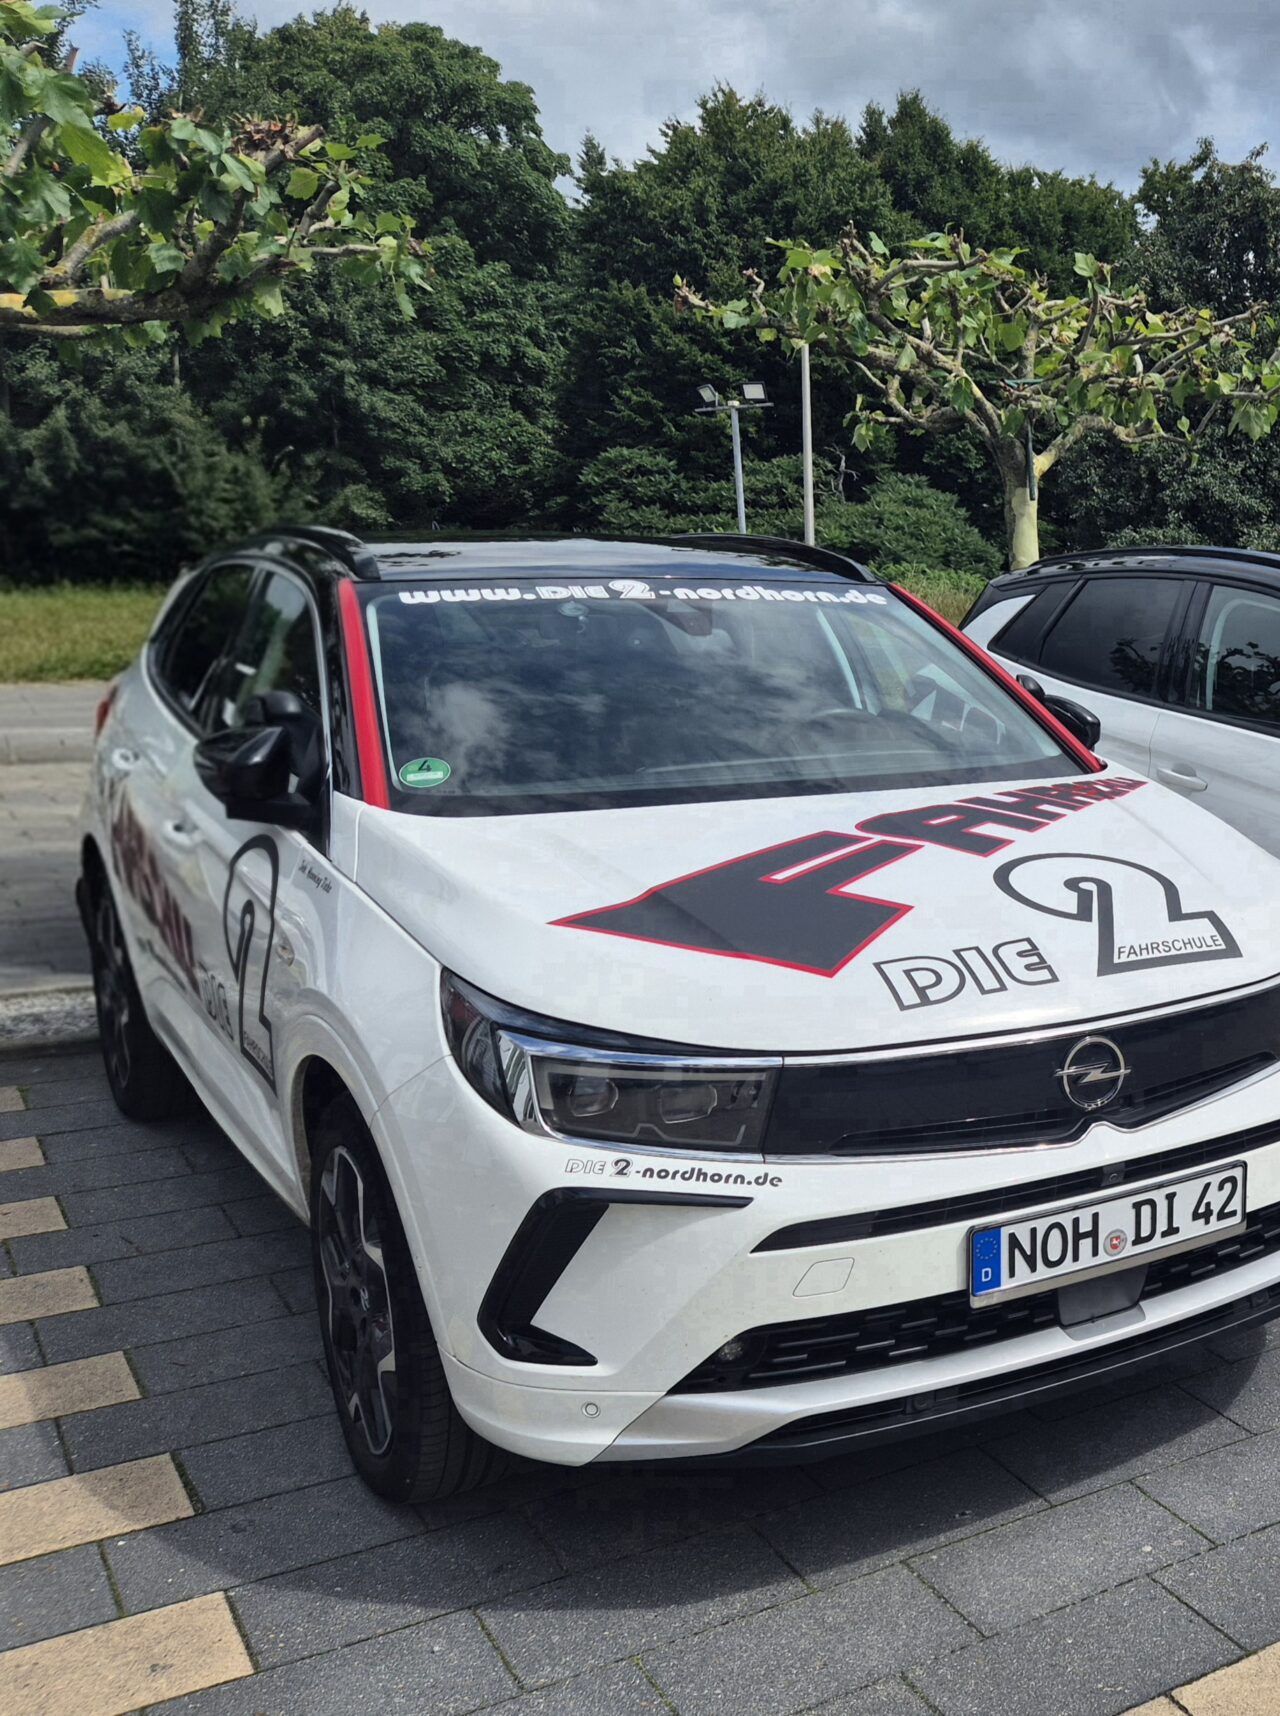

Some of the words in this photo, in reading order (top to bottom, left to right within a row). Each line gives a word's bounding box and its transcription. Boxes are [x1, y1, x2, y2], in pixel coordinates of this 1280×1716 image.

[873, 937, 1059, 1012] DIE
[993, 852, 1243, 977] 2
[1116, 934, 1223, 960] FAHRSCHULE
[981, 1267, 992, 1282] D
[1008, 1211, 1100, 1279] NOH
[1131, 1191, 1180, 1247] DI
[1191, 1175, 1239, 1226] 42
